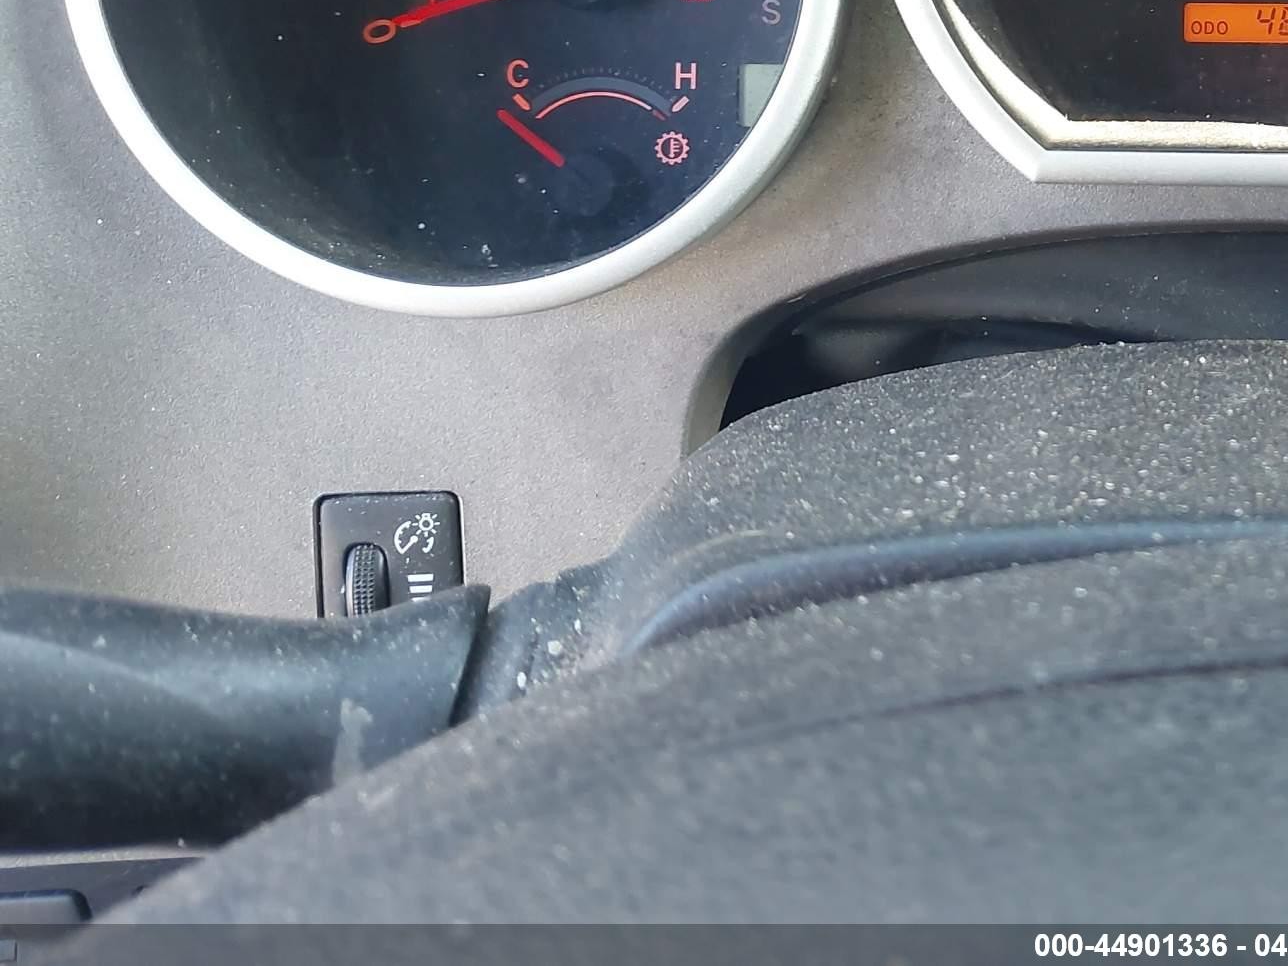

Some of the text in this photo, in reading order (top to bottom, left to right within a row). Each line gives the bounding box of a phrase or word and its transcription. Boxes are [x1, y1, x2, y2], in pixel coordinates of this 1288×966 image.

[762, 0, 780, 24] S
[363, 19, 396, 44] 0
[1191, 21, 1228, 34] ODO
[507, 60, 529, 88] C
[675, 62, 697, 89] H
